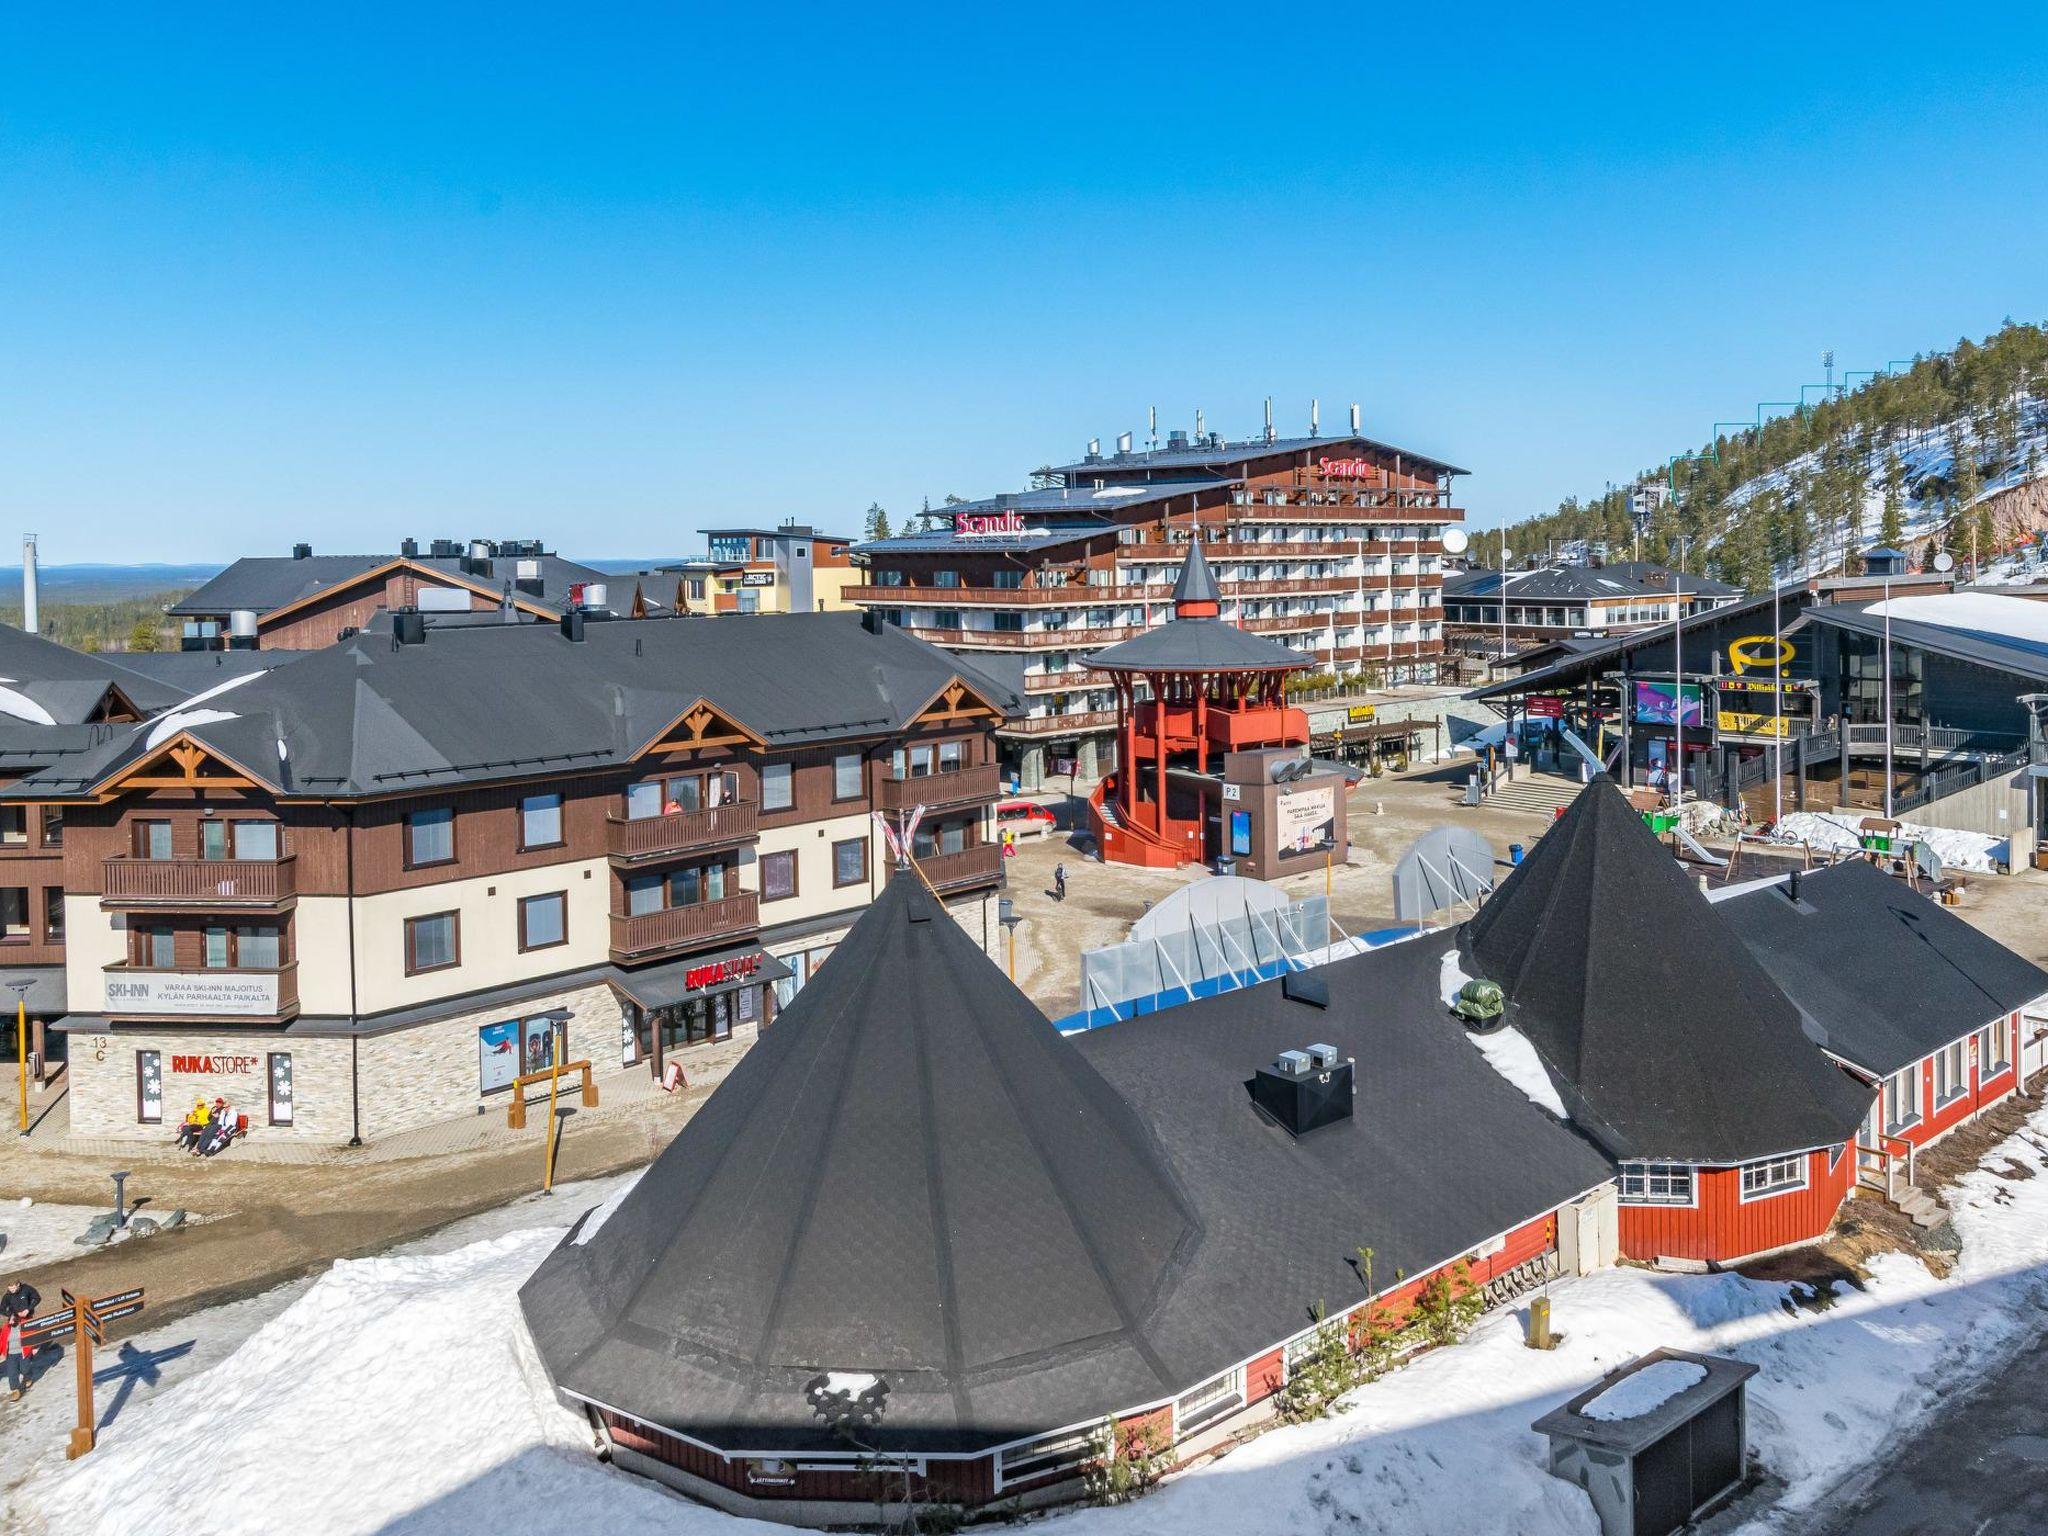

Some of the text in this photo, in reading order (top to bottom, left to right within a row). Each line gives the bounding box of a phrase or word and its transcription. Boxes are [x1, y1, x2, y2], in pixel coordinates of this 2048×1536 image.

[1319, 457, 1371, 478] Scandic
[955, 509, 1026, 534] Scandic
[108, 983, 149, 998] SKI-INN
[164, 984, 263, 993] VARAA SKI-INN MAJOITUS
[186, 992, 232, 1001] PARHAALTA
[233, 994, 271, 1002] PAIKALTA
[93, 1037, 107, 1049] 13
[96, 1051, 105, 1062] C
